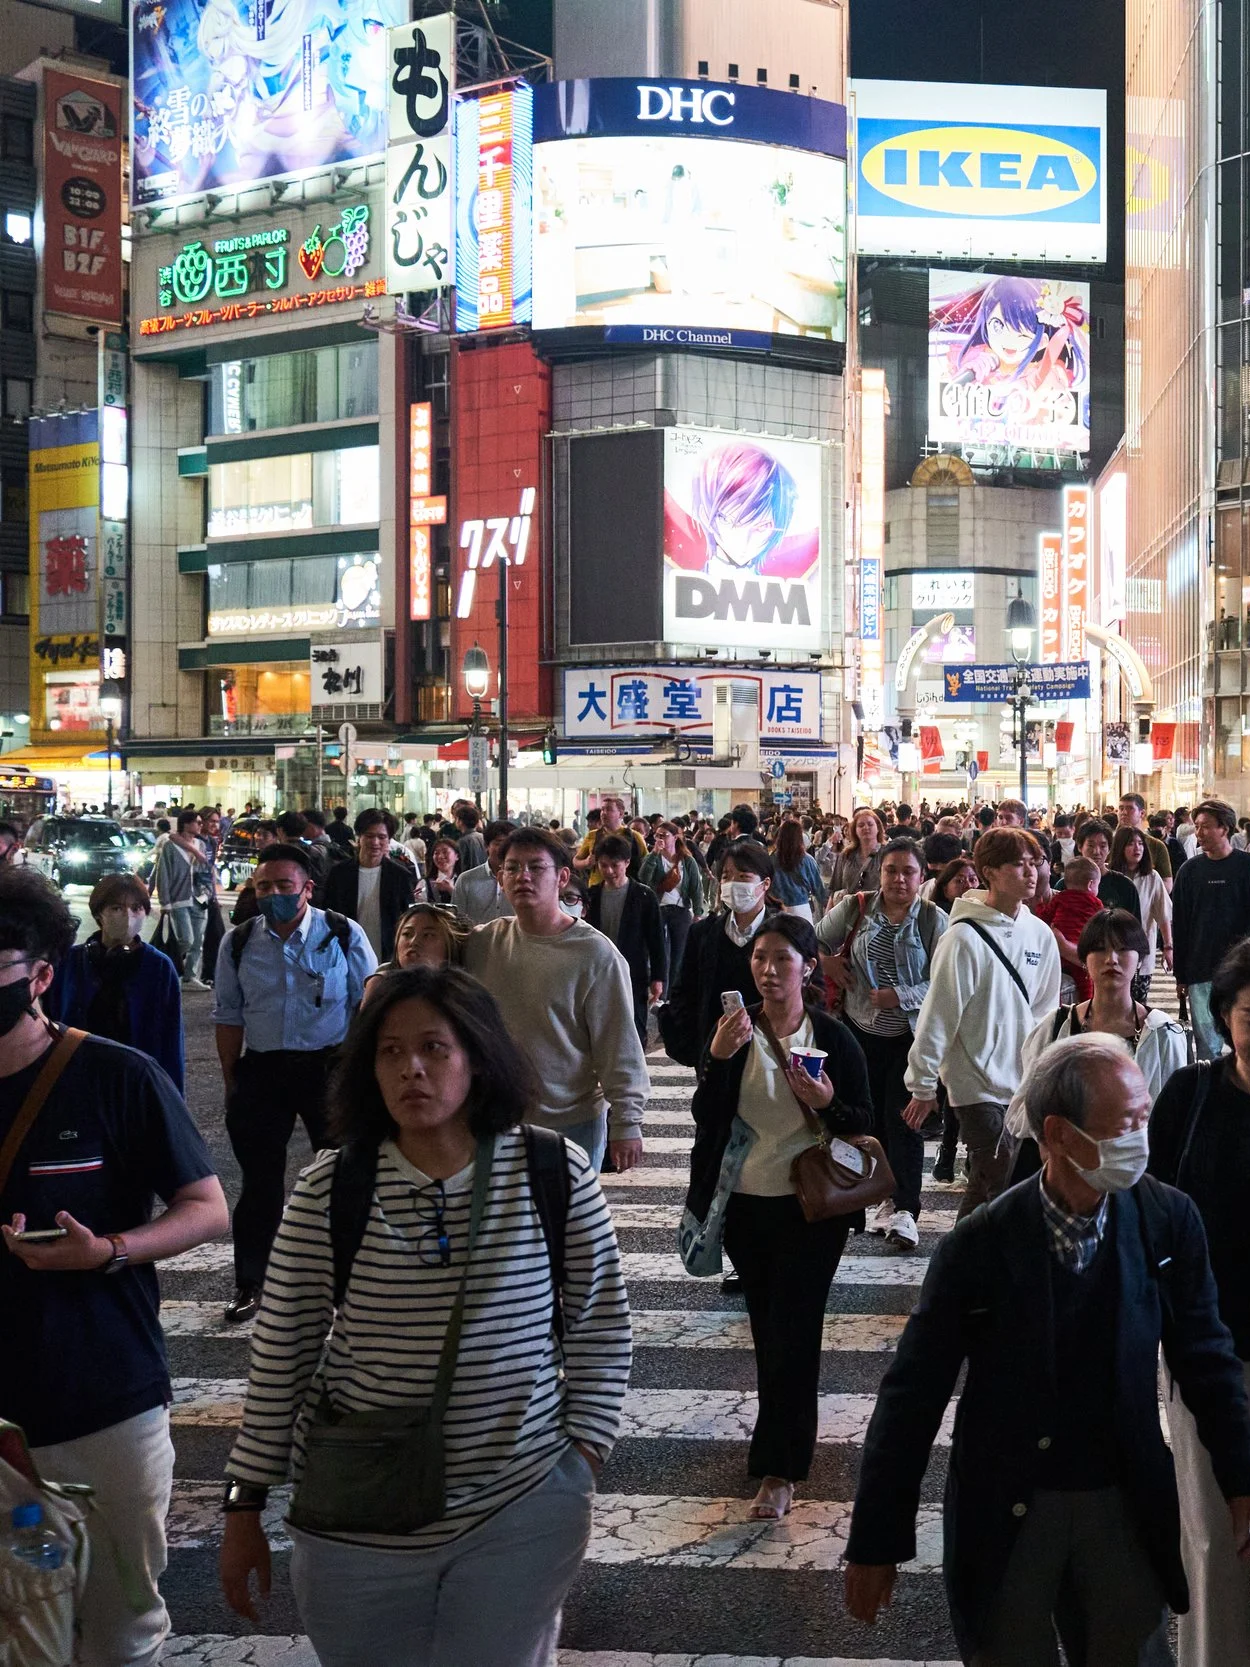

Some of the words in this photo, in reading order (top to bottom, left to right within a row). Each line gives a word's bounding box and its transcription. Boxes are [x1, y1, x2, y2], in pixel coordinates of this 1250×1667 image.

[636, 84, 736, 126] DHC
[392, 28, 449, 280] もんじゃ
[884, 148, 1081, 192] IKEA
[477, 99, 505, 315] 三千里薬品
[63, 223, 105, 249] B1F
[215, 229, 288, 253] FRUITS&PARLOR
[63, 250, 107, 276] B2F
[215, 246, 287, 298] 西村
[159, 266, 172, 307] 渋谷
[642, 329, 675, 343] DHC
[677, 330, 732, 345] Channel
[34, 459, 80, 473] Matsumoto
[1067, 501, 1088, 595] カラオケ
[675, 574, 811, 626] DMM
[963, 665, 1089, 684] 全国交通全運動実施中
[576, 679, 804, 724] 大盛堂店
